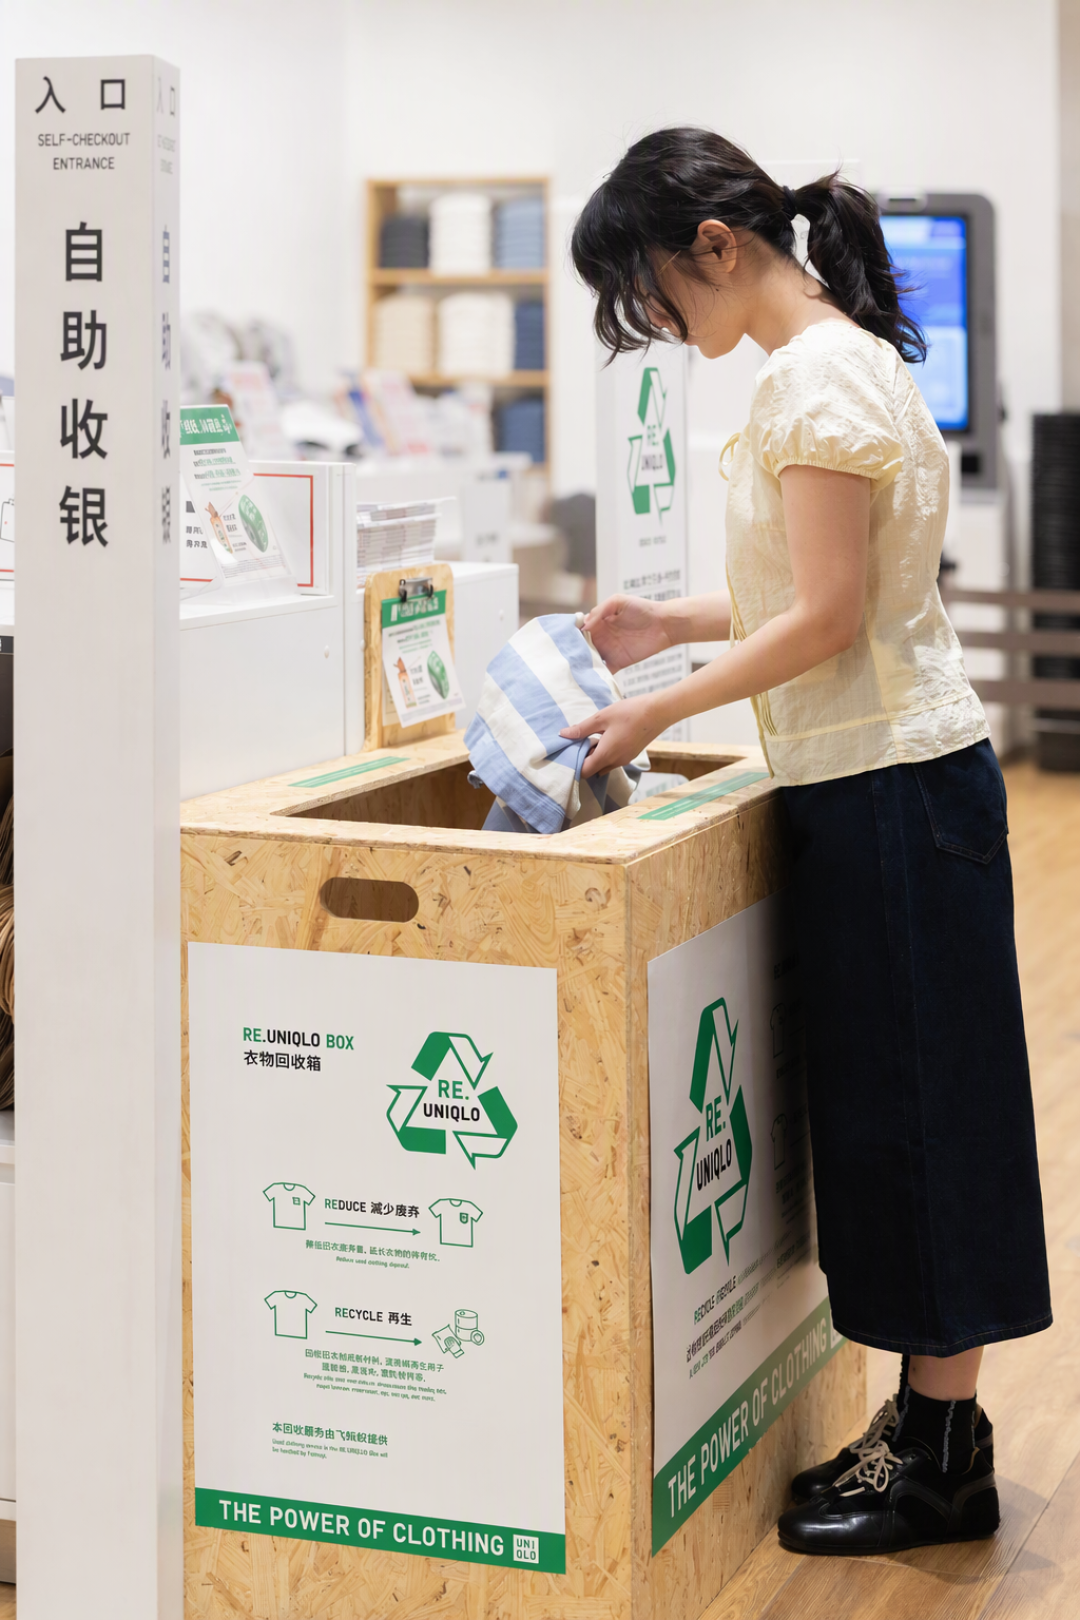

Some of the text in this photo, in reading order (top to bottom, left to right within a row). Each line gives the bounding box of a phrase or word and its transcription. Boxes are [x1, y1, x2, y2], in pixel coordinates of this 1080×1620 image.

[35, 76, 126, 114] 入口
[37, 132, 131, 147] SELF-CHECKOUT
[53, 156, 115, 171] ENTRANCE
[59, 221, 108, 548] 自助收银
[243, 1027, 354, 1050] RE.UNIQLO BOX
[243, 1049, 321, 1071] 衣物回收箱
[438, 1079, 469, 1100] RE.
[423, 1103, 480, 1122] UNIQLO
[705, 1095, 726, 1142] RE.
[696, 1138, 732, 1191] UNIQLO
[324, 1198, 366, 1213] REDUCE
[335, 1307, 412, 1326] RECYCLE 再生
[668, 1454, 696, 1518] THE
[701, 1400, 749, 1486] POWER
[752, 1377, 769, 1426] OF
[771, 1317, 827, 1406] CLOTHING
[219, 1499, 504, 1557] THE POWER OF CLOTHING
[516, 1538, 535, 1550] UNI
